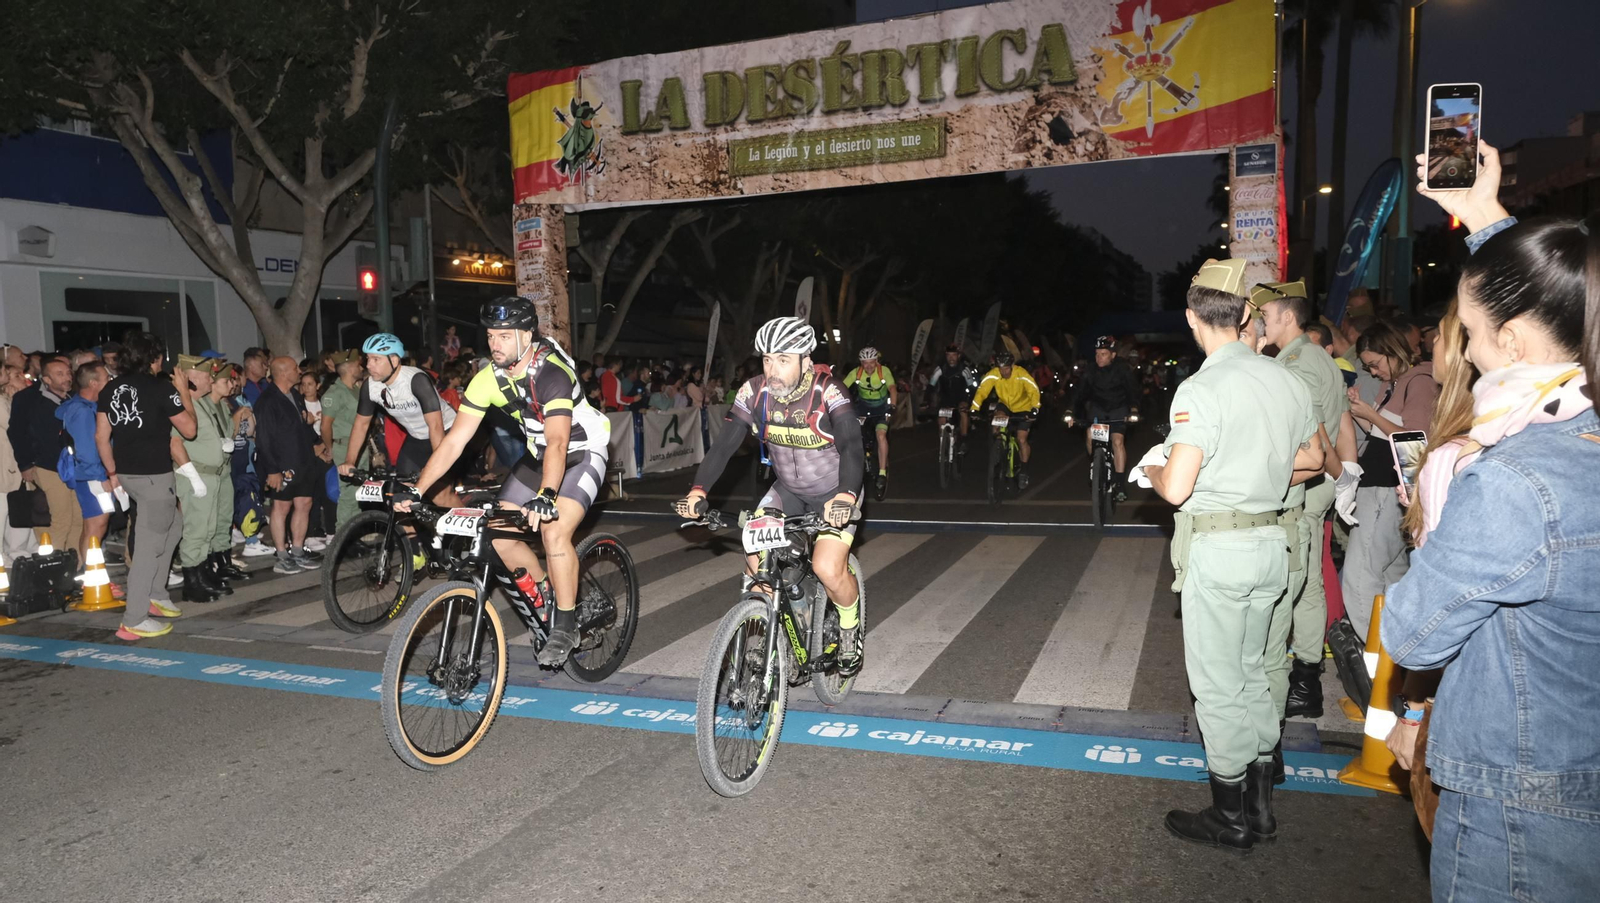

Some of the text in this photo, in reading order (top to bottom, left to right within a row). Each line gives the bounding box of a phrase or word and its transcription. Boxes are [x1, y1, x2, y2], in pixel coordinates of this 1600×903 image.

[620, 22, 1079, 135] LA DESÉRTICA
[748, 134, 921, 162] La Legión y el desierto nos une
[1236, 210, 1274, 218] GRUPO
[1236, 217, 1274, 229] RENTA
[255, 257, 300, 273] DE
[649, 453, 665, 462] Junta
[360, 485, 380, 497] 7822
[749, 527, 782, 546] 7444
[90, 652, 185, 667] cajamar
[237, 669, 347, 686] cajamar
[415, 687, 539, 706] caaar
[867, 729, 1034, 752] cajamar
[942, 744, 1025, 757] CAJA RURAL
[1294, 776, 1348, 786] RURAL
